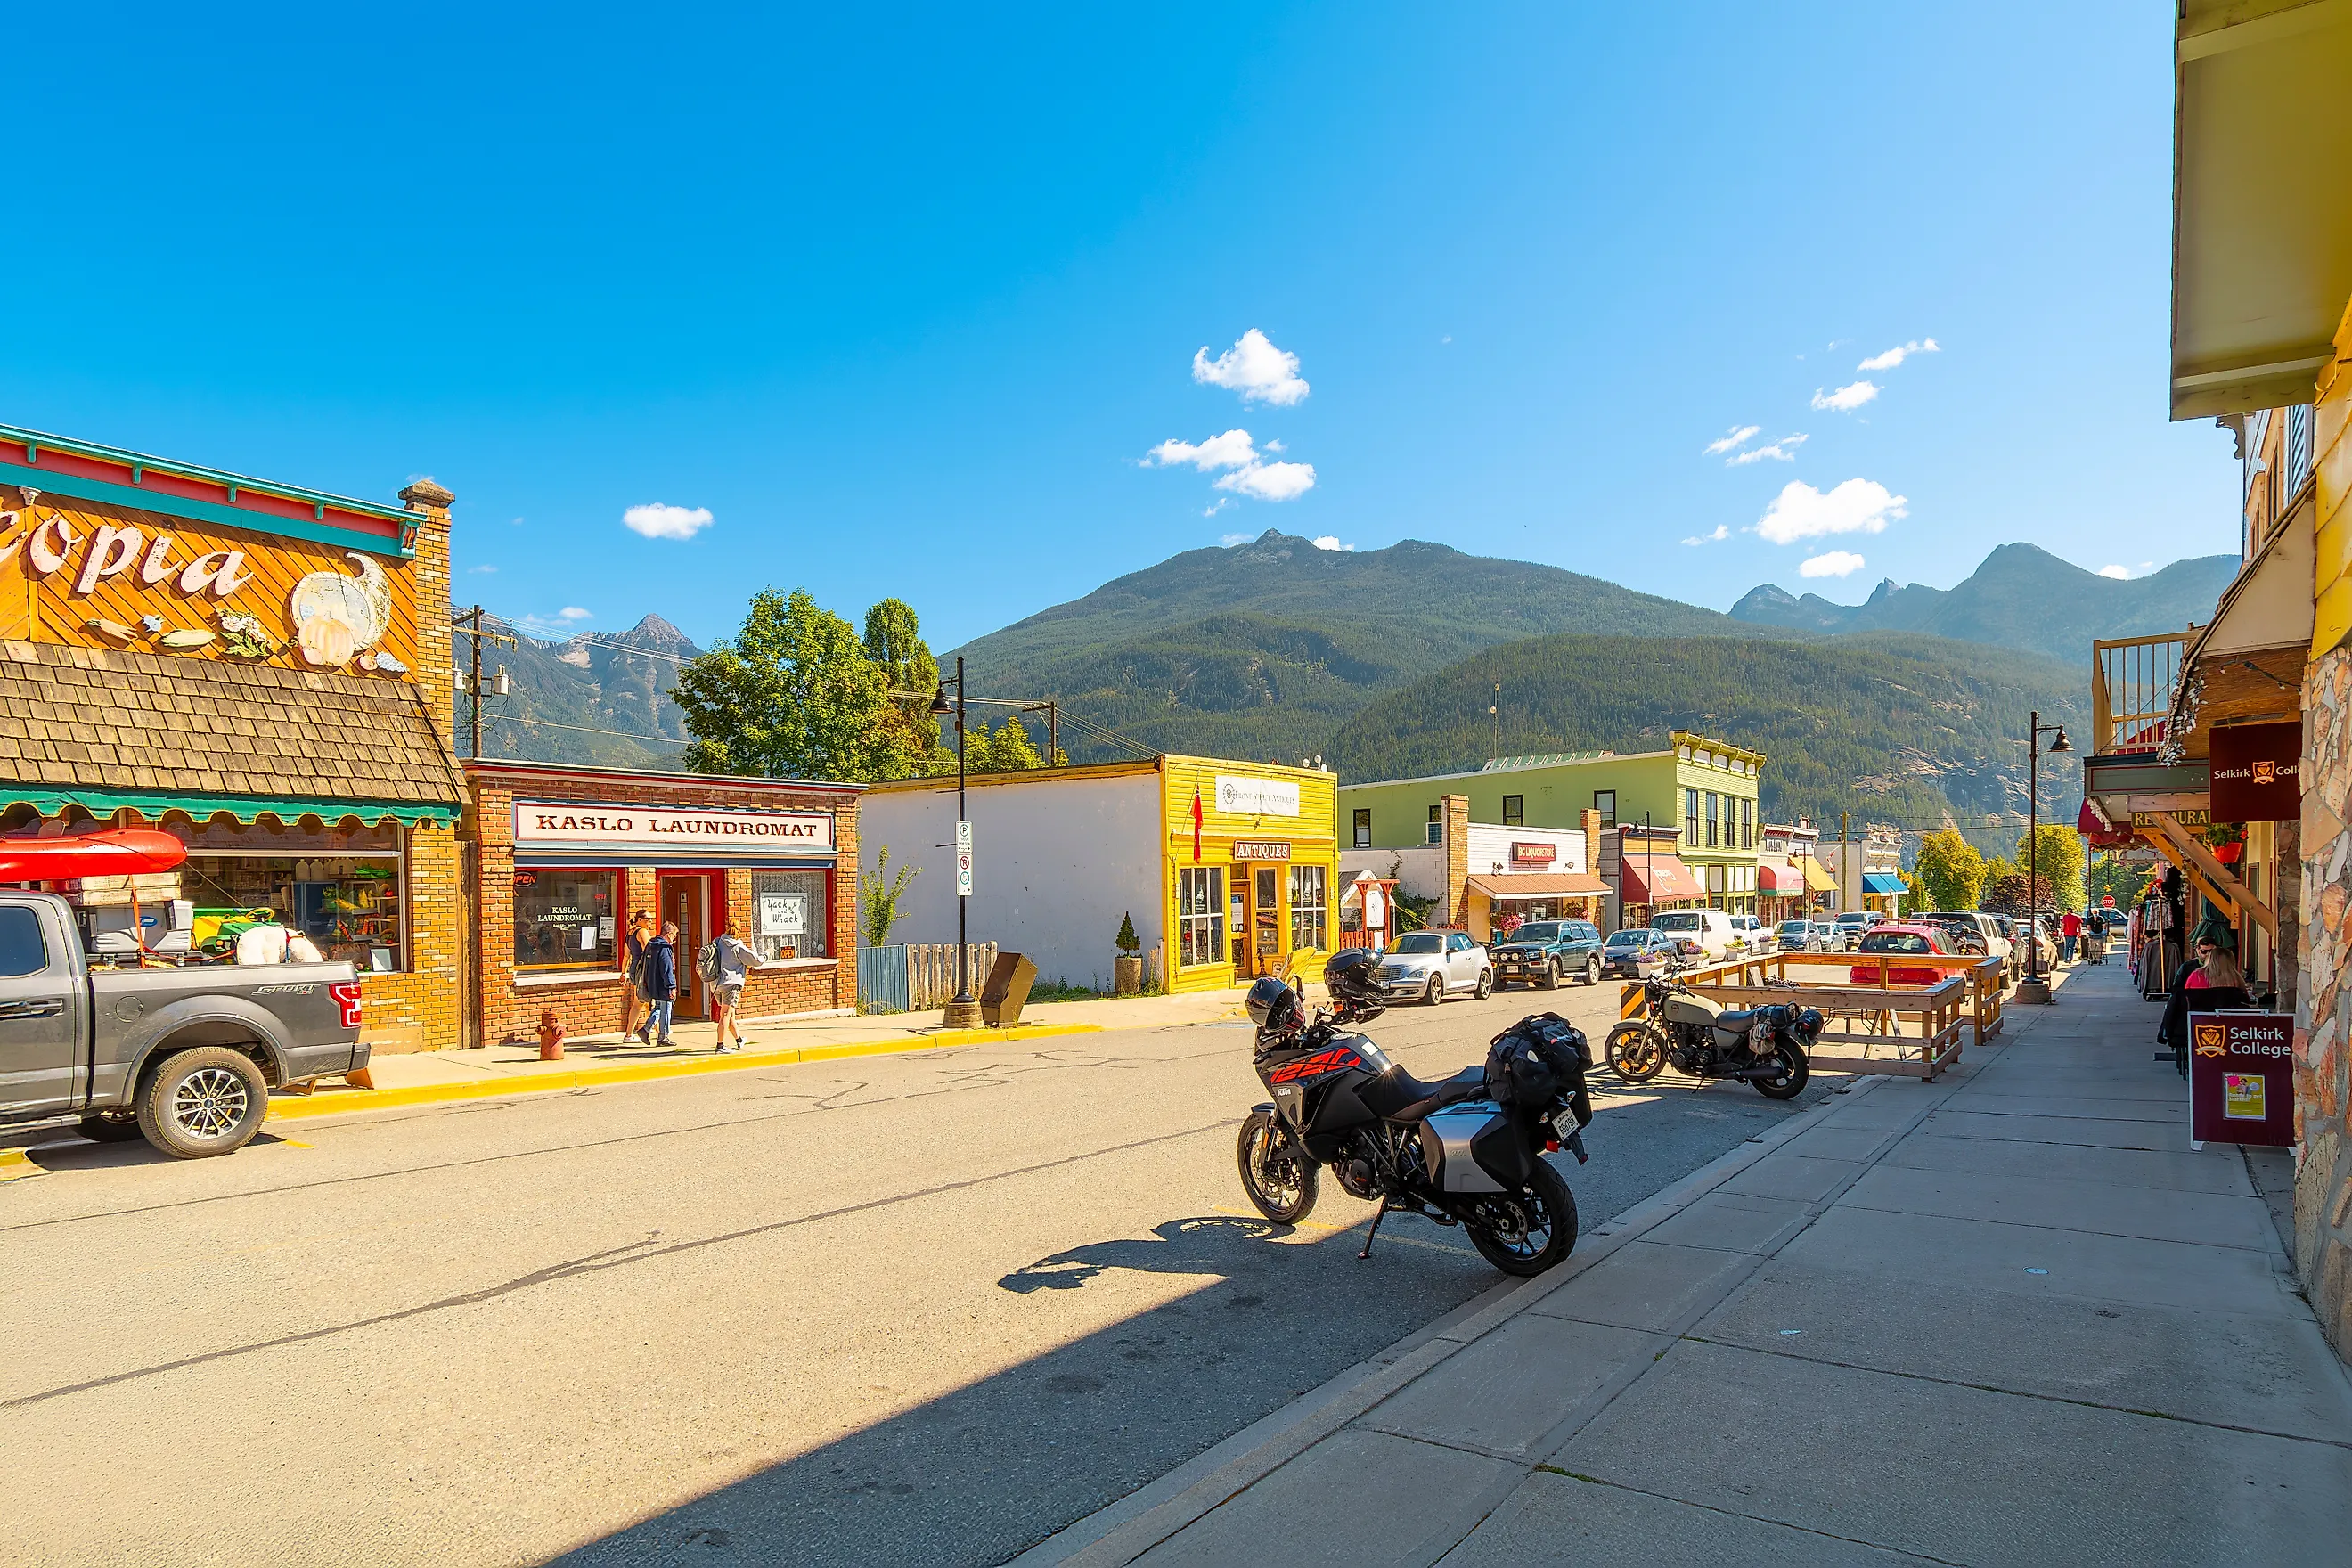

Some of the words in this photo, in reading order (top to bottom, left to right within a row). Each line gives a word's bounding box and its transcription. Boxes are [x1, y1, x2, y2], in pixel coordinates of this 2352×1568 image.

[2214, 768, 2251, 779] Selkirk
[2275, 764, 2299, 776] Coll
[535, 814, 633, 832] KASLO
[649, 818, 818, 837] LAUNDROMAT
[1237, 844, 1288, 859] ANTIQUES
[1518, 846, 1525, 857] BC
[513, 875, 537, 884] PEN
[551, 906, 578, 914] KASLO
[767, 898, 788, 912] Yack
[537, 914, 592, 922] LAUNDROMAT
[772, 913, 798, 924] Whack
[780, 949, 796, 959] OPEN
[2230, 1027, 2285, 1041] Selkirk
[2230, 1041, 2291, 1058] College
[1277, 1088, 1292, 1097] KTM
